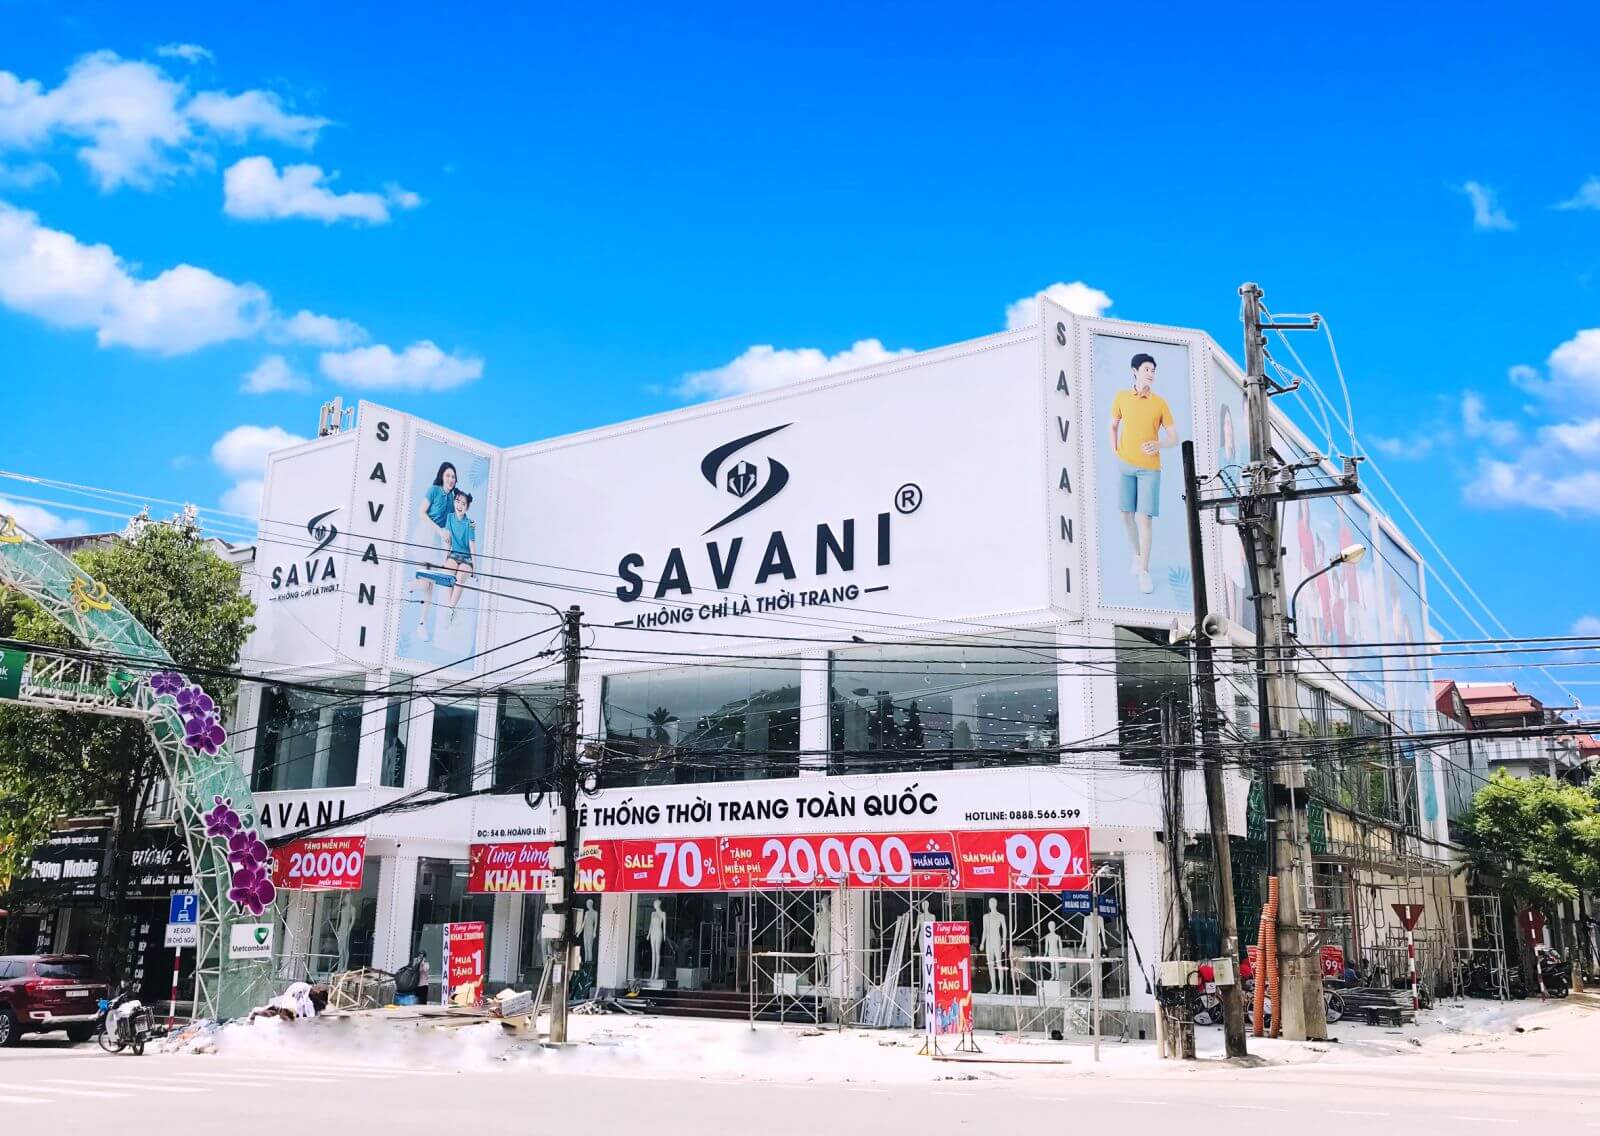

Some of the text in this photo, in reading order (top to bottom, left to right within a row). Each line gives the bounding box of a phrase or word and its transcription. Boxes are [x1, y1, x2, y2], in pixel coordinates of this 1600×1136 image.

[1056, 321, 1073, 593] SAVANI
[358, 421, 390, 647] SAVANI
[616, 512, 890, 602] SAVANI
[636, 585, 859, 628] KHÔNG CHỈ LÀ THỜI TRANG
[594, 797, 660, 826] THỐNG
[666, 796, 712, 823] THỜI
[718, 798, 789, 821] TRANG
[796, 790, 856, 818] TOÀN
[863, 783, 938, 816] QUỐC
[965, 809, 1080, 821] HOTLINE: 0888.566.599
[507, 826, 531, 836] HOÀNG
[62, 859, 99, 878] Mobile
[288, 851, 361, 878] 20.000
[624, 854, 654, 868] SALE
[746, 862, 761, 873] PHÍ
[484, 869, 606, 891] KHAI TRNG
[184, 896, 193, 909] P
[232, 944, 270, 952] Vietcombank
[455, 957, 472, 965] MUA
[471, 950, 482, 976] 1
[940, 966, 958, 975] MUA
[925, 925, 933, 1034] SAVANI
[957, 958, 968, 992] 1
